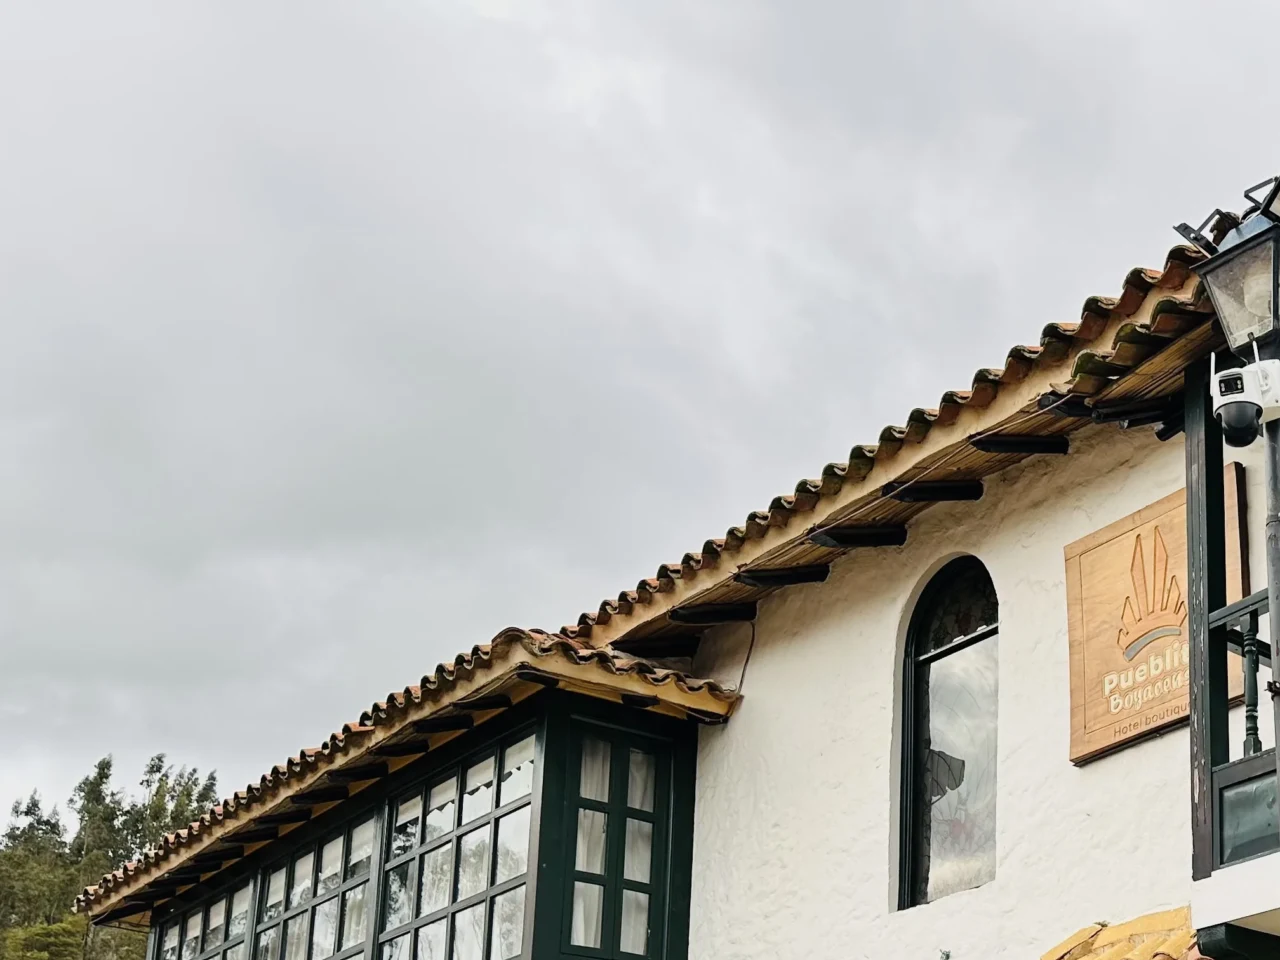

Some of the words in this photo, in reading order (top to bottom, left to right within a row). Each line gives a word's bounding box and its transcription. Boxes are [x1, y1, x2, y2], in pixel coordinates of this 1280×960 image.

[1102, 640, 1190, 697] Pueblit
[1109, 669, 1190, 713] Boyacens
[1113, 714, 1143, 738] Hotel
[1145, 701, 1190, 727] boutiqu
